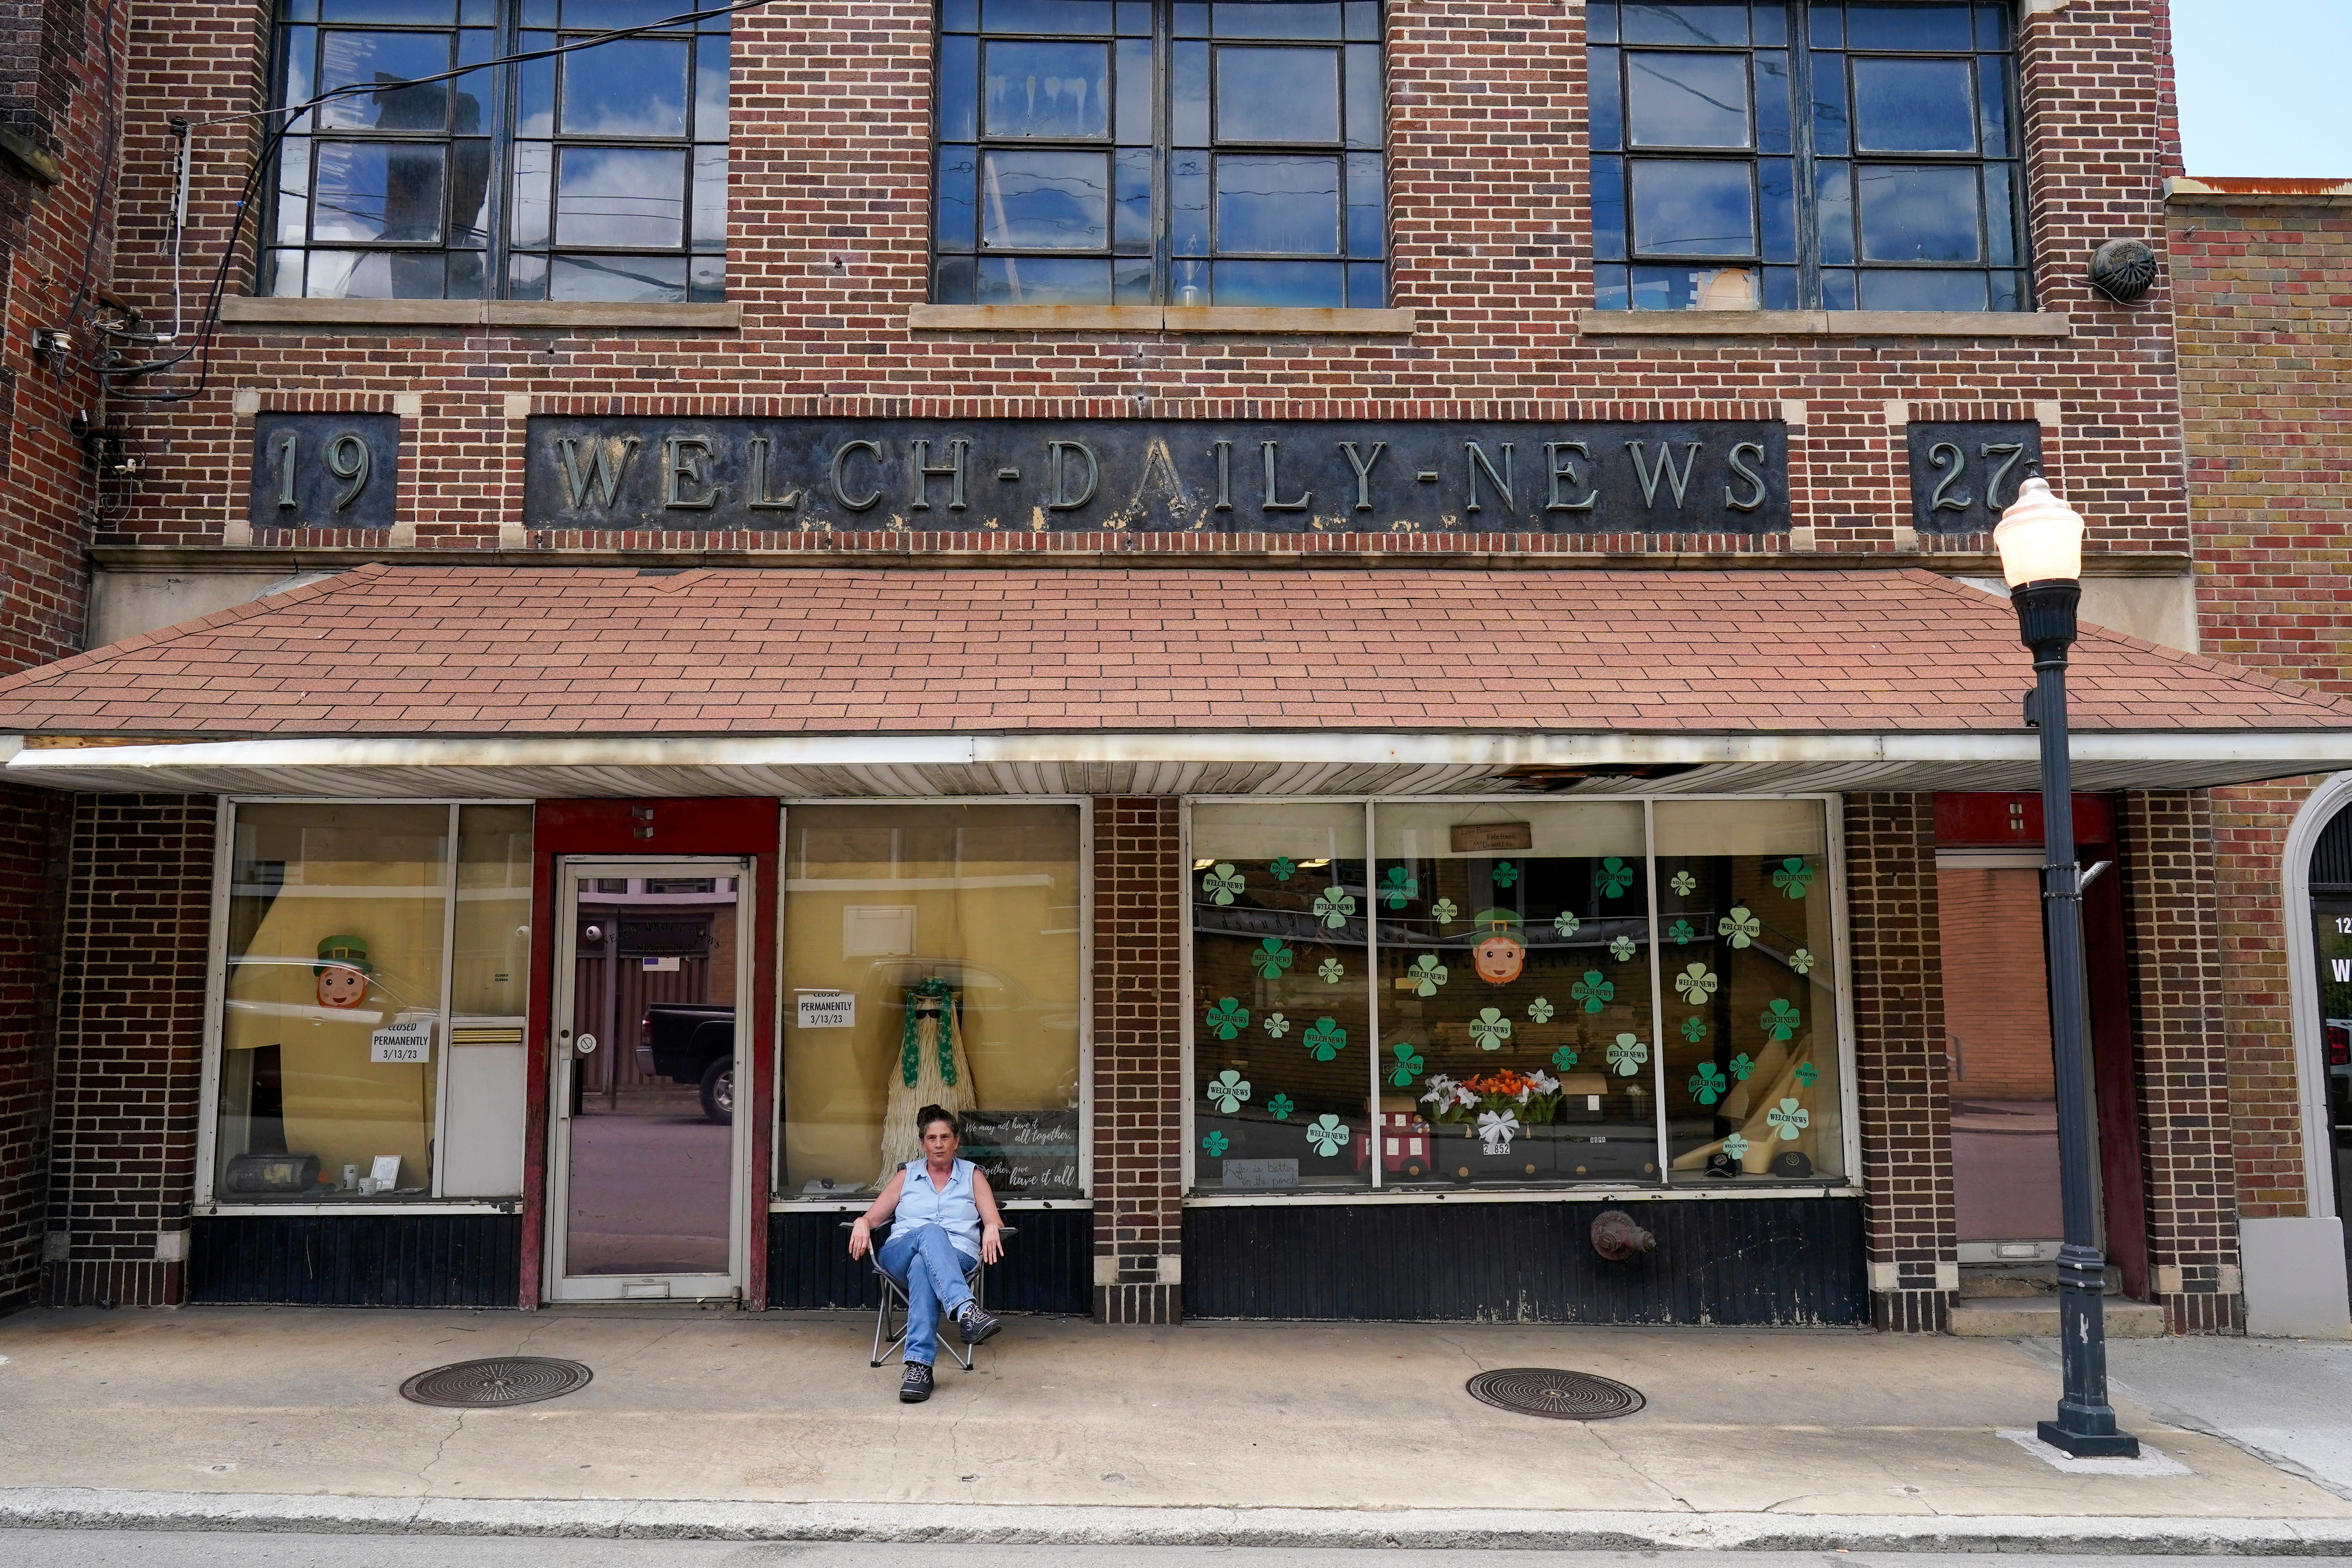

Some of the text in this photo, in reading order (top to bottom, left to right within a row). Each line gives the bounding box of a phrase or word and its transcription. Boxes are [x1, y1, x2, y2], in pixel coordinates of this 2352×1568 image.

[2109, 242, 2140, 259] RELIABLE
[278, 436, 369, 510] 19
[1928, 442, 2024, 511] 27
[597, 927, 638, 946] WELCH
[2332, 959, 2352, 982] W
[801, 1002, 852, 1011] PERMANENTLY
[811, 1014, 842, 1025] 3/13/23
[374, 1036, 428, 1045] PERMANENTLY
[383, 1049, 417, 1060] 3/13/23
[966, 1117, 1039, 1135] We may not have it
[1310, 1129, 1330, 1138] WELCH
[1015, 1125, 1071, 1145] all together,
[1484, 1144, 1509, 1154] 2852
[985, 1161, 1011, 1178] gether,
[1009, 1165, 1075, 1186] have it all
[1224, 1161, 1248, 1180] Life
[1268, 1160, 1298, 1173] better
[1242, 1173, 1298, 1187] on the porch
